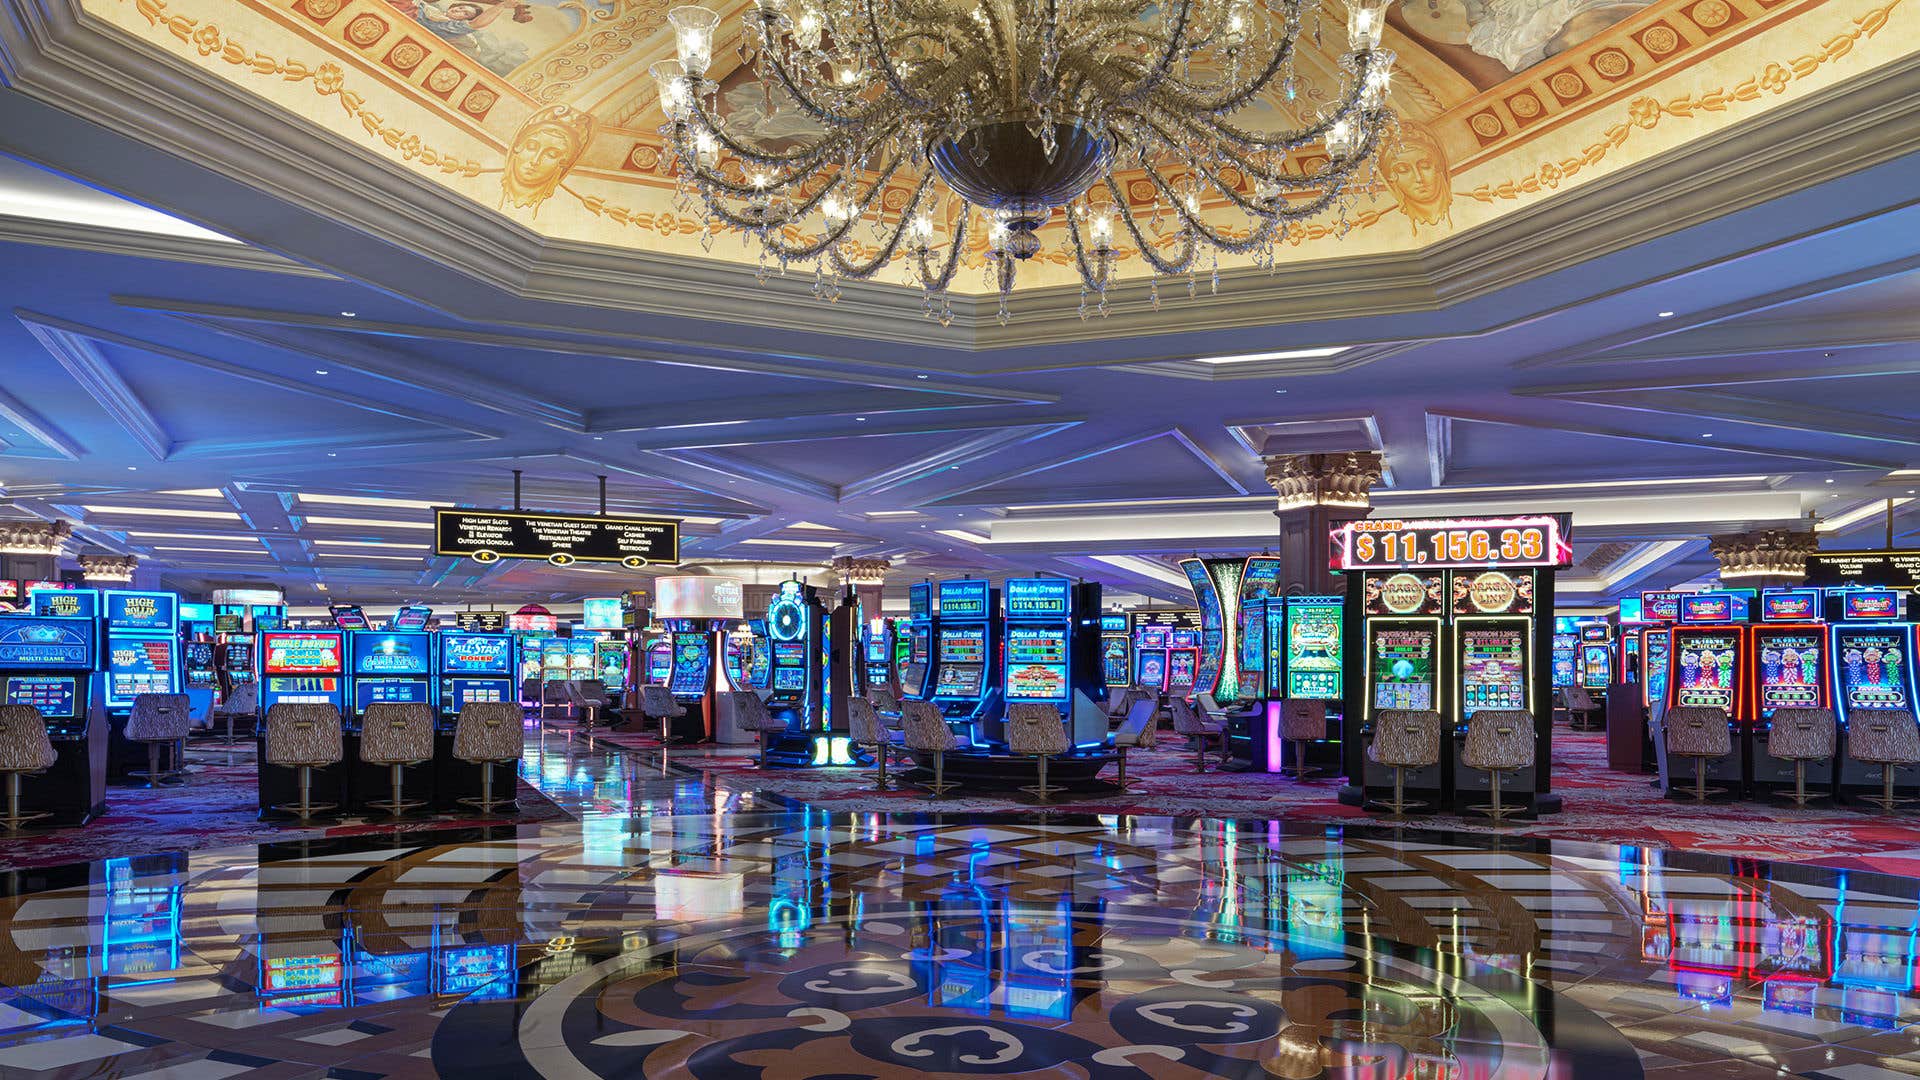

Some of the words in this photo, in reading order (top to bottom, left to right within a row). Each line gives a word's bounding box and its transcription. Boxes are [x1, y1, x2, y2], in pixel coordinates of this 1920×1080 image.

[1354, 520, 1403, 532] GRAND
[476, 531, 504, 539] ELEVATOR
[543, 527, 570, 535] VENETIAN
[457, 537, 486, 545] OUTDOOR
[486, 538, 514, 546] GONDOLA
[538, 534, 571, 542] RESTAURANT
[571, 535, 586, 543] ROW
[630, 538, 652, 546] PARKING
[551, 541, 572, 549] SPHERE
[619, 544, 650, 552] RESTROOMS
[1356, 528, 1543, 564] $11,156.33
[941, 587, 963, 596] DOLLAR
[1009, 585, 1039, 594] DOLLAR
[1038, 584, 1066, 595] STORM
[51, 596, 79, 606] HIGH
[125, 598, 155, 607] HIGH
[1390, 594, 1418, 606] LINK
[1010, 630, 1038, 639] DOLLAR
[1038, 629, 1063, 639] STORM
